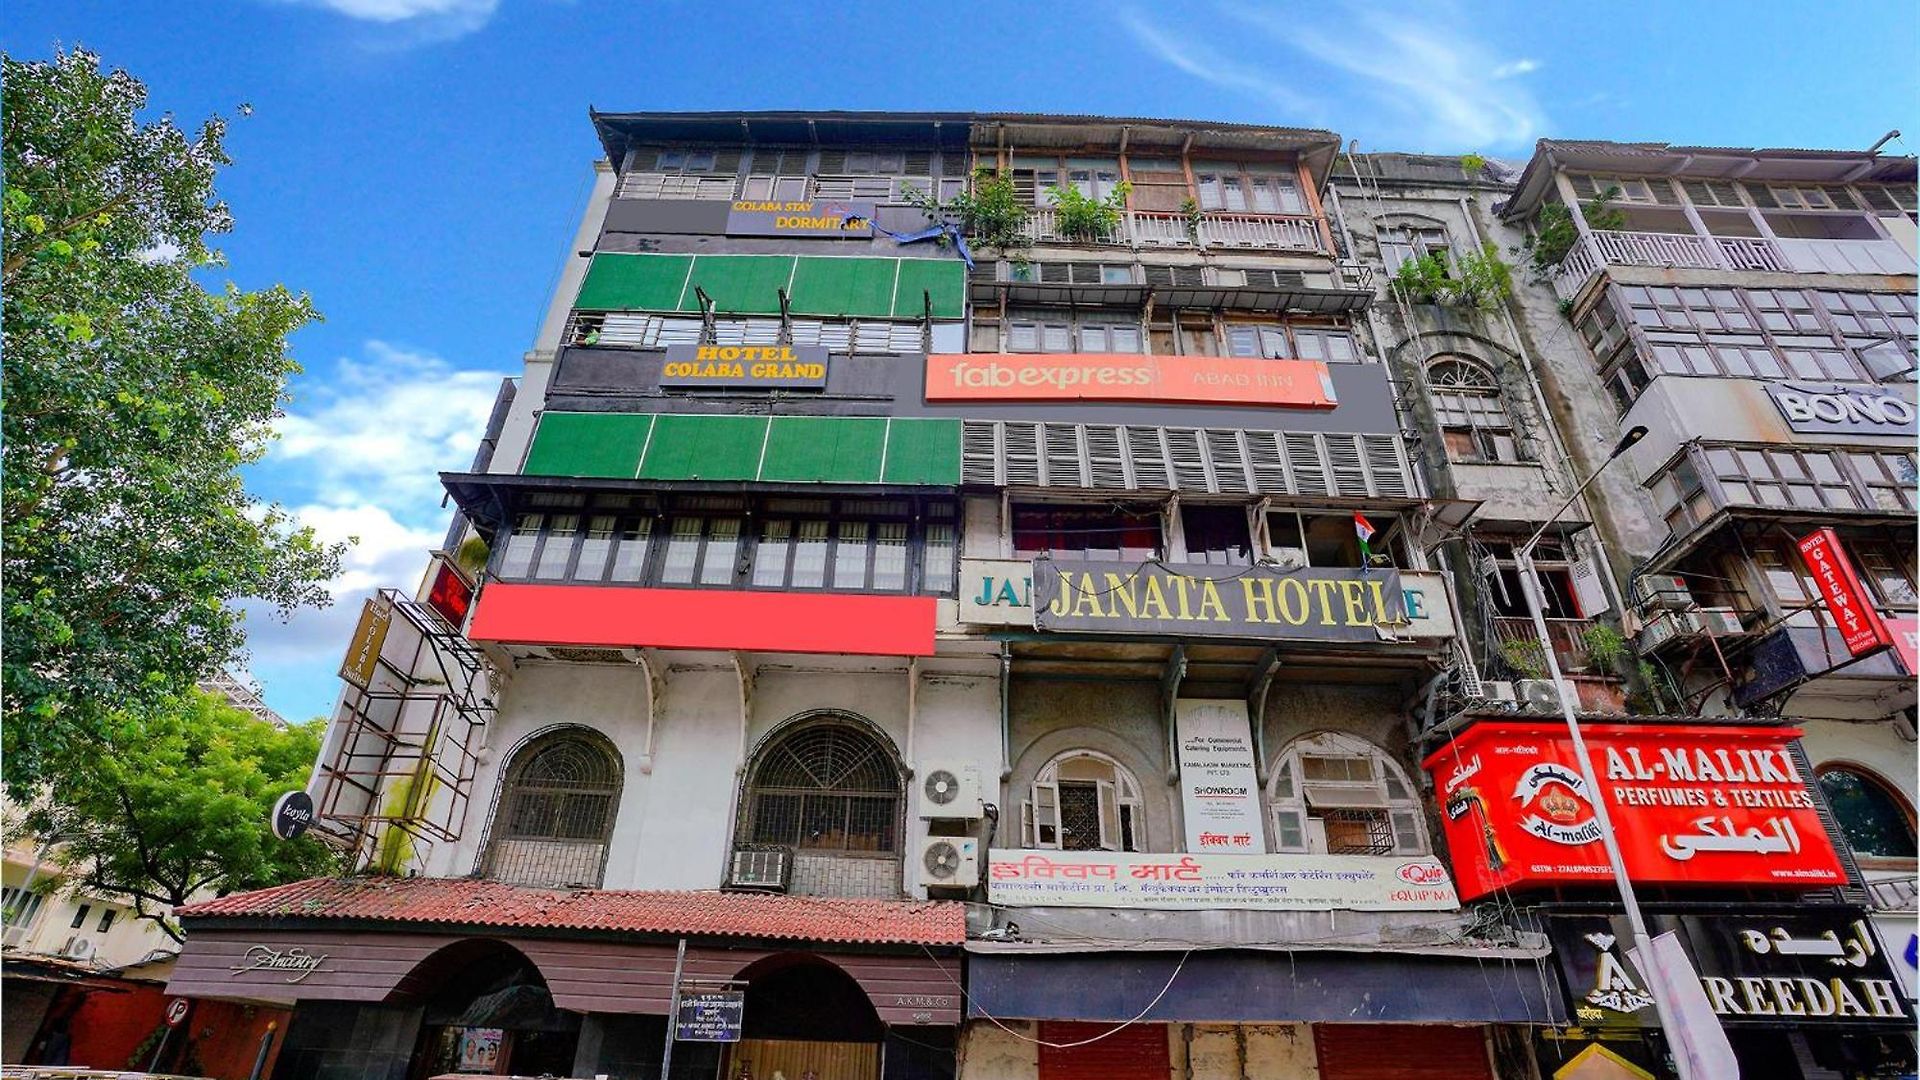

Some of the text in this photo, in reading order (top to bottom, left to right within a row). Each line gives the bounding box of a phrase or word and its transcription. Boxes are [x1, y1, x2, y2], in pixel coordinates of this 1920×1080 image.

[732, 201, 814, 212] COLABA STAY
[697, 346, 798, 362] HOTEL
[664, 362, 825, 378] COLABA GRAND
[1193, 371, 1294, 387] ABAD INN
[1774, 391, 1915, 425] BONO
[1801, 535, 1825, 552] HOTEL
[1050, 571, 1402, 627] JANATA HOTEL
[1812, 547, 1859, 631] GATEWAY
[1606, 746, 1803, 783] AL-MALIKI
[1194, 786, 1248, 796] SHOWROOM
[1613, 786, 1814, 809] PERFUMES & TEXTILES
[1128, 856, 1203, 881] मार्ट
